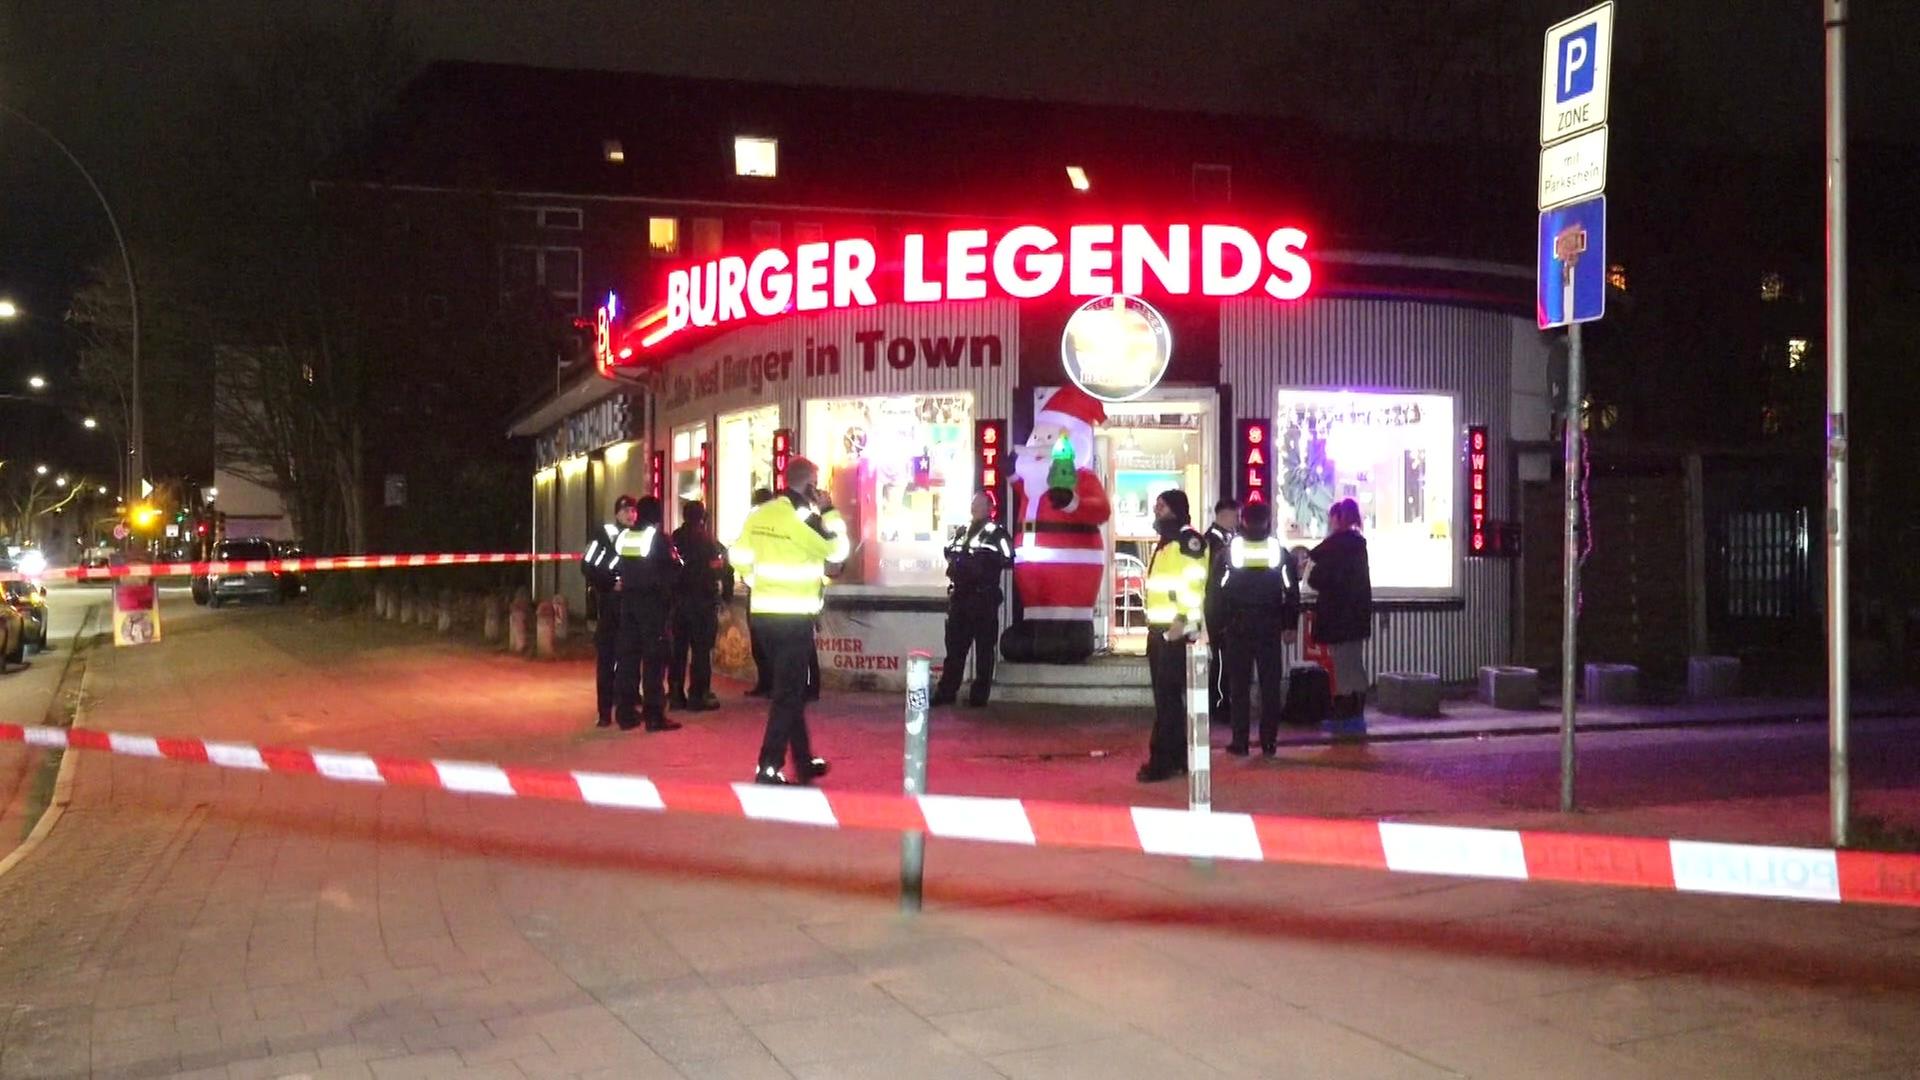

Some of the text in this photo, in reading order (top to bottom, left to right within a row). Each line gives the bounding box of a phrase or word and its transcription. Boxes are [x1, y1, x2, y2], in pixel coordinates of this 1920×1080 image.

[1564, 36, 1587, 93] P
[1557, 103, 1590, 132] ZONE
[1544, 164, 1600, 194] Parkschein
[666, 224, 1312, 333] BURGER LEGENDS
[806, 337, 840, 378] in
[855, 330, 1003, 372] Town
[1247, 426, 1264, 505] SALA
[1472, 433, 1484, 549] SWEETS
[833, 655, 899, 670] GARTEN
